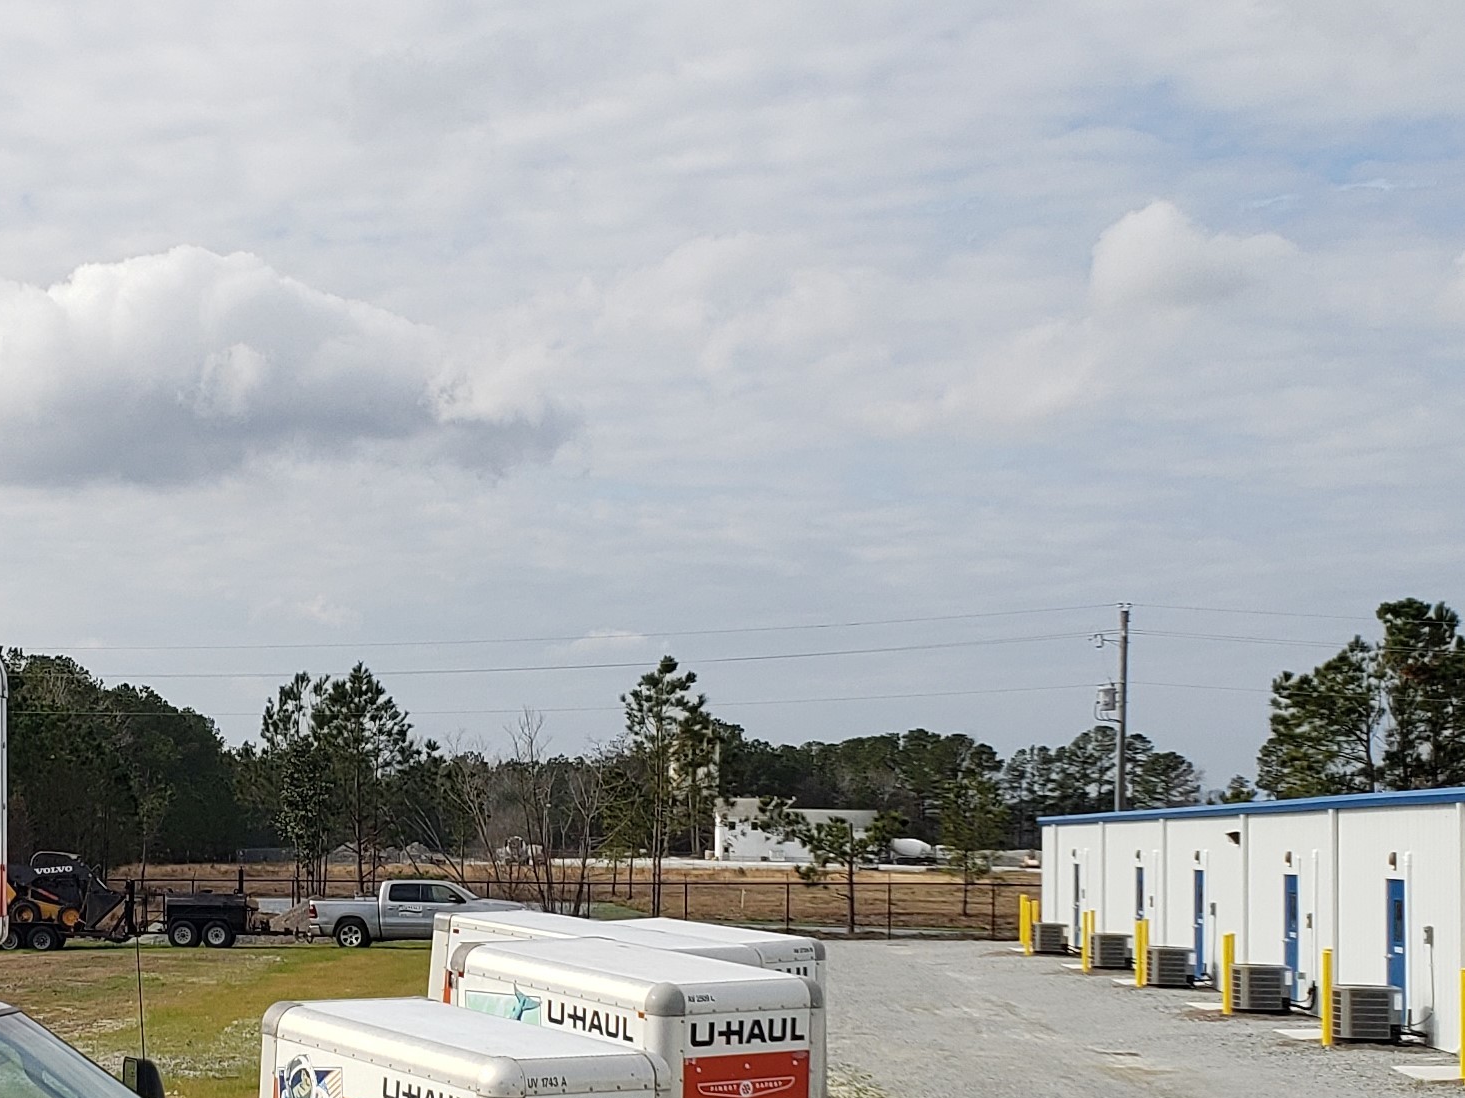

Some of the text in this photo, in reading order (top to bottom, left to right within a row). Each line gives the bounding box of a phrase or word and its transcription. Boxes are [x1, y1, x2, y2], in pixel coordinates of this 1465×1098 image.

[34, 865, 74, 875] VOLVO
[547, 999, 634, 1043] U-HAUL
[690, 1017, 806, 1048] U-HAUL
[527, 1076, 568, 1088] UV 1743 A
